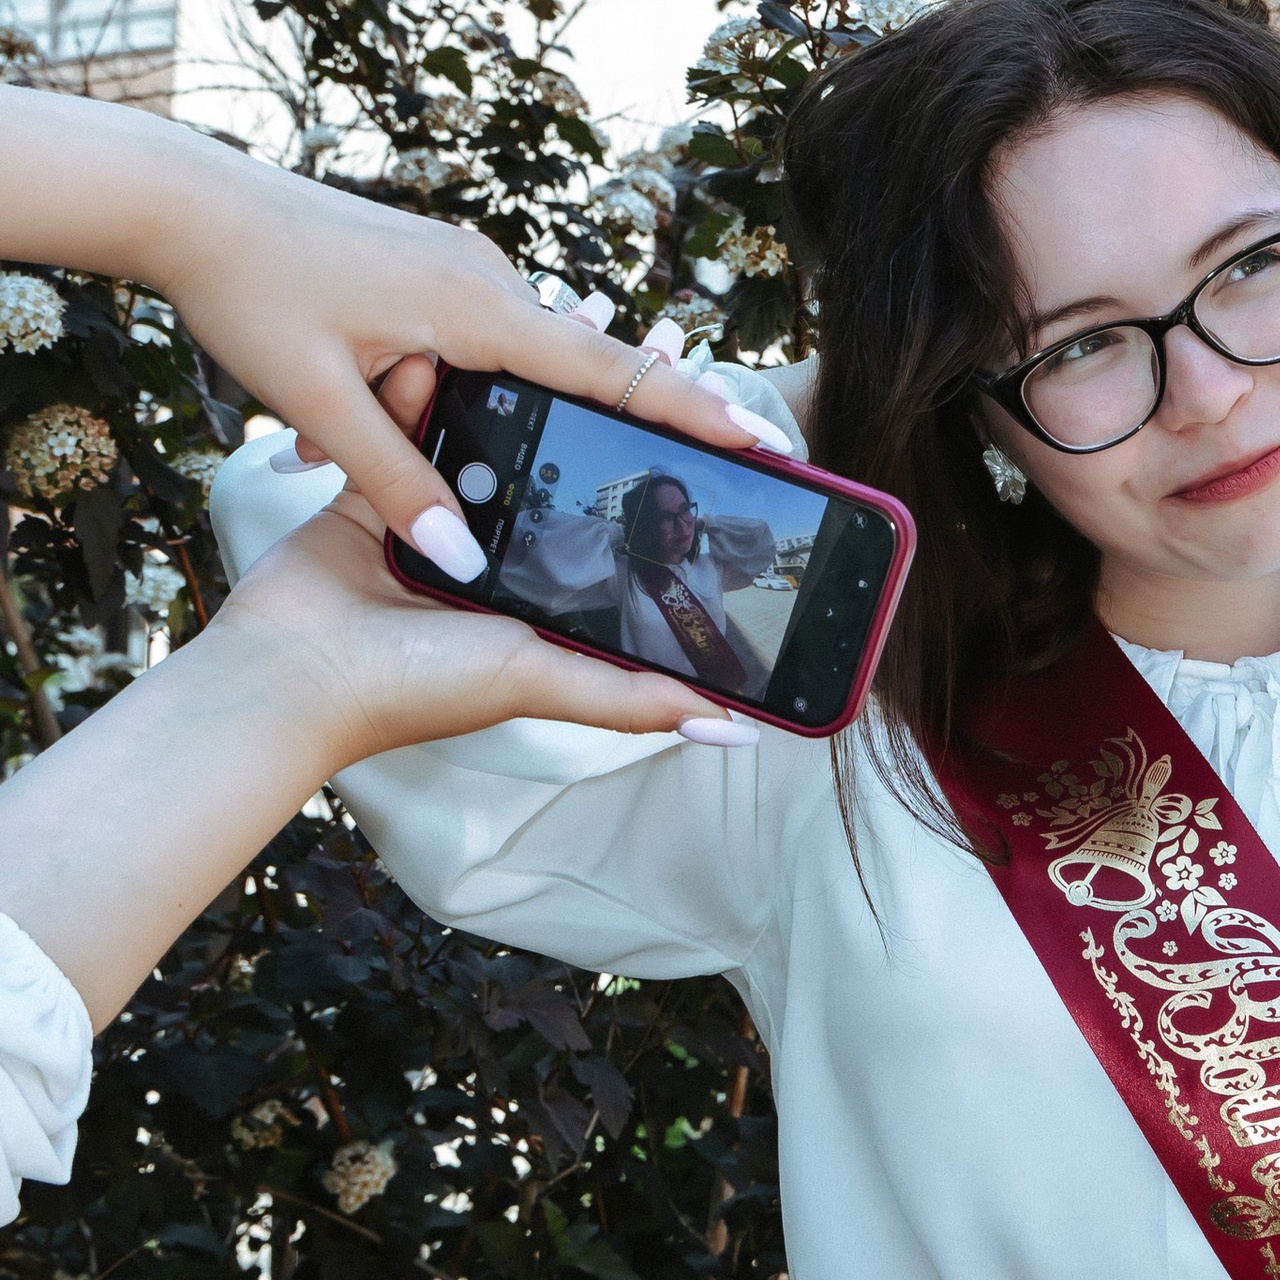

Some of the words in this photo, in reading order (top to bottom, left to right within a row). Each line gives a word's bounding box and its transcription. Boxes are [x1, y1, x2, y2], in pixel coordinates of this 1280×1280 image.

[514, 442, 528, 471] ВИДЕО
[503, 483, 515, 506] ФОТО
[489, 518, 505, 553] ПОРТРЕТ
